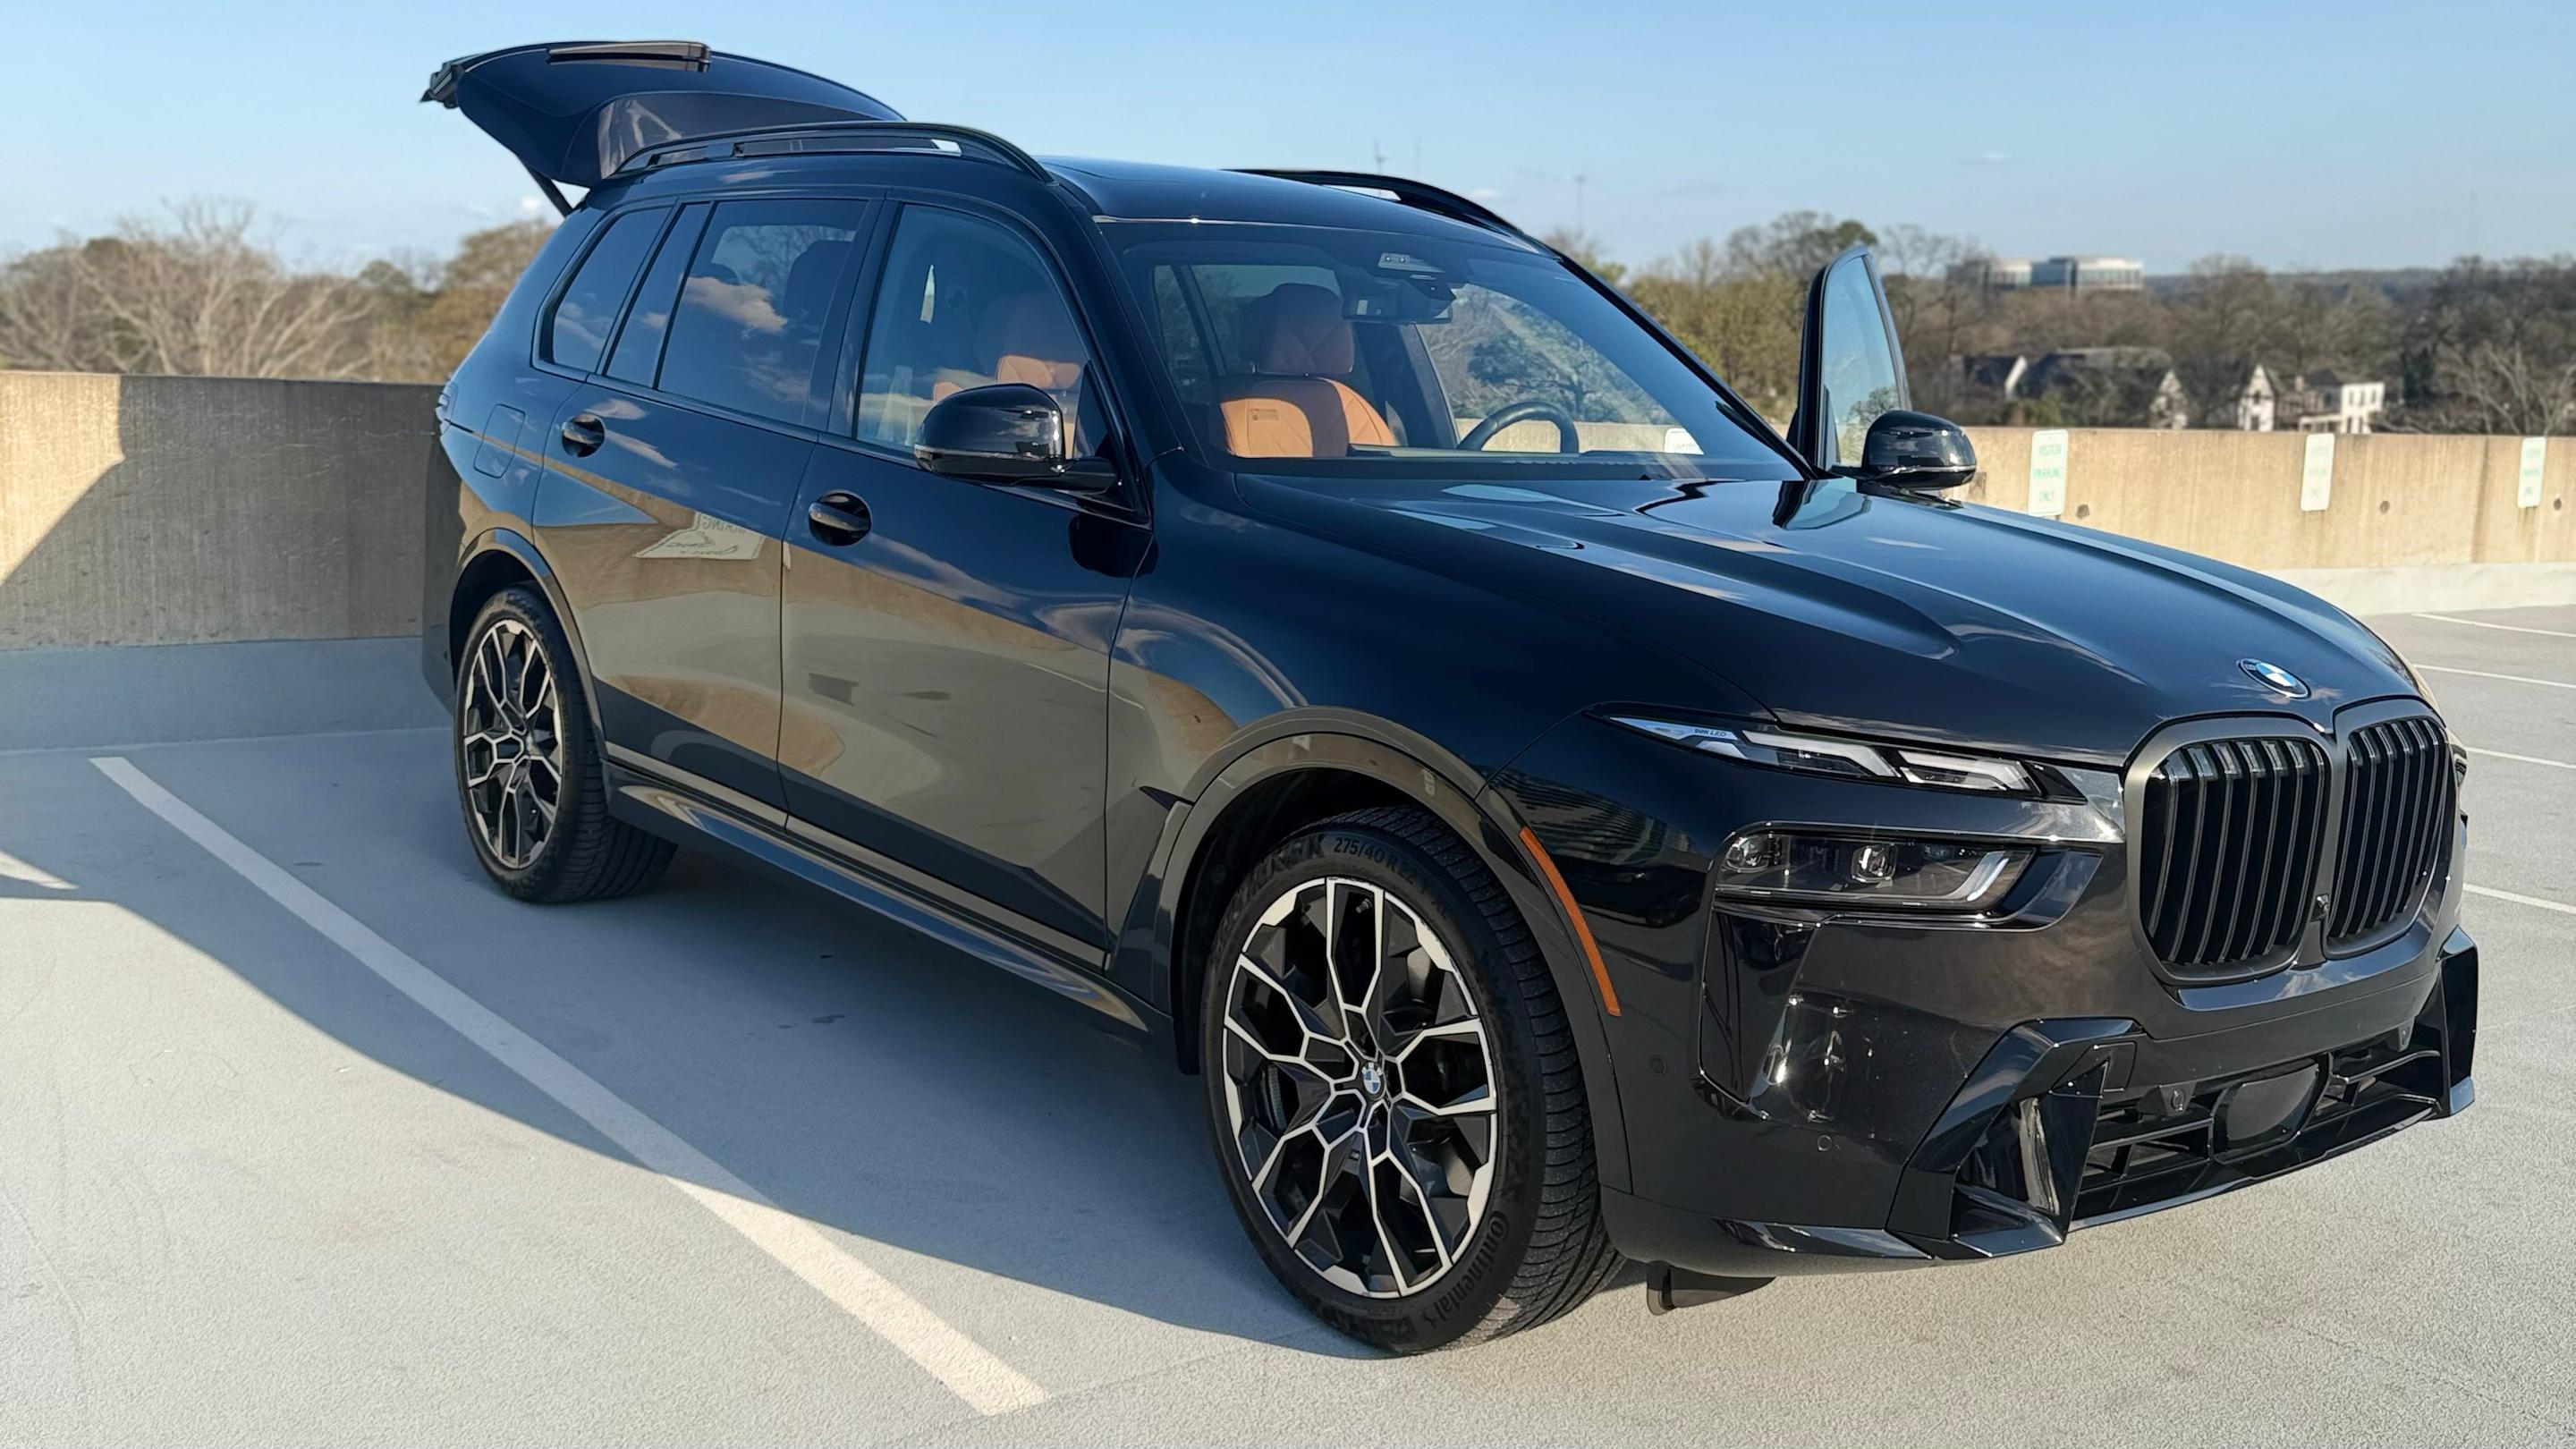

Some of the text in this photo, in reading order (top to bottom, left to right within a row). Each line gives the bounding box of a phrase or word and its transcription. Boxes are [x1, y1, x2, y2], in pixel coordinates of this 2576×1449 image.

[1334, 836, 1385, 864] 275/40
[1385, 854, 1397, 871] R
[1361, 1062, 1383, 1076] BMW
[1435, 1210, 1510, 1321] Continental
